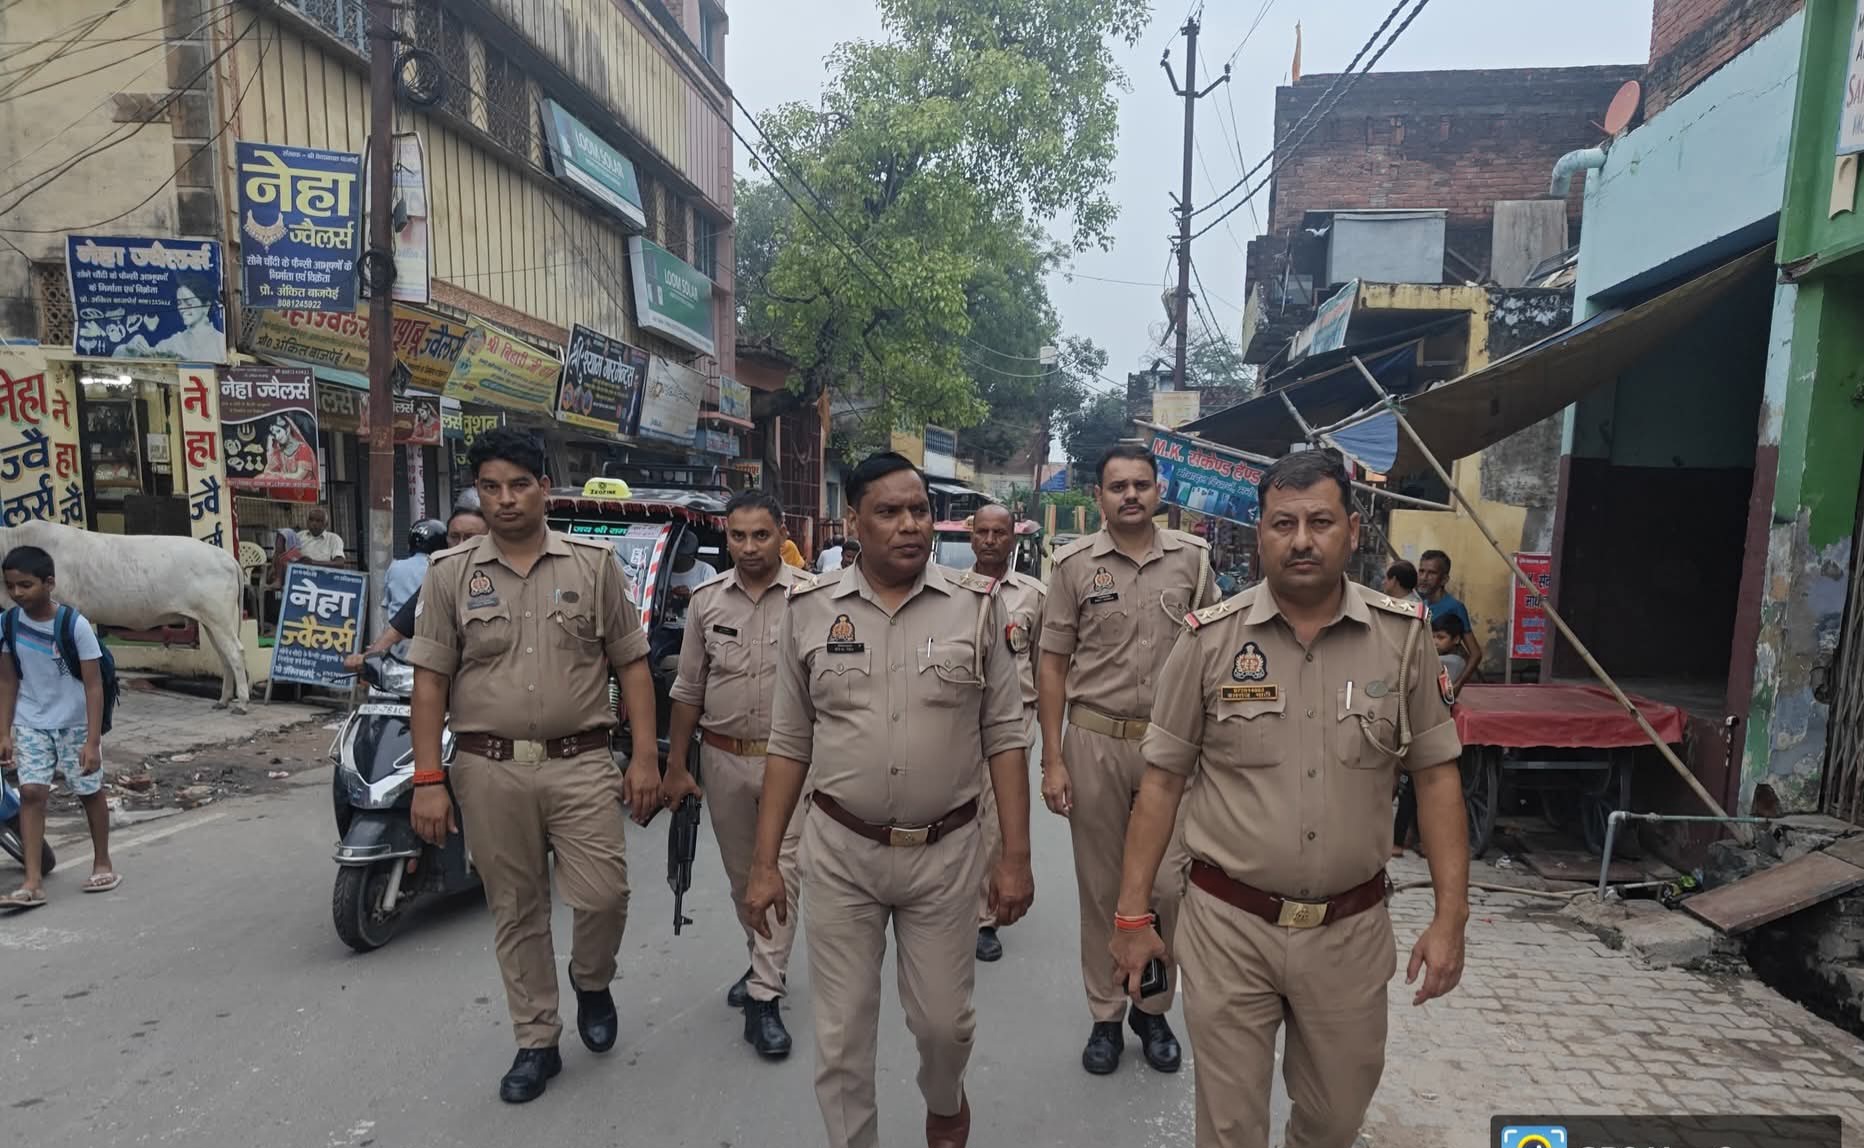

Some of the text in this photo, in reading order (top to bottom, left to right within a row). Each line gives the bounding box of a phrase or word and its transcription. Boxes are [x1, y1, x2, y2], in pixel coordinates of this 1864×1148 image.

[242, 150, 356, 217] नेहा
[288, 218, 355, 249] ज्वैलर्स
[221, 375, 311, 400] नेहा ज्वैलर्स
[1152, 437, 1185, 462] M.K.
[573, 525, 593, 534] जय
[593, 524, 609, 534] श्री
[289, 578, 357, 619] नेहा
[280, 615, 357, 653] ज्वैलर्स
